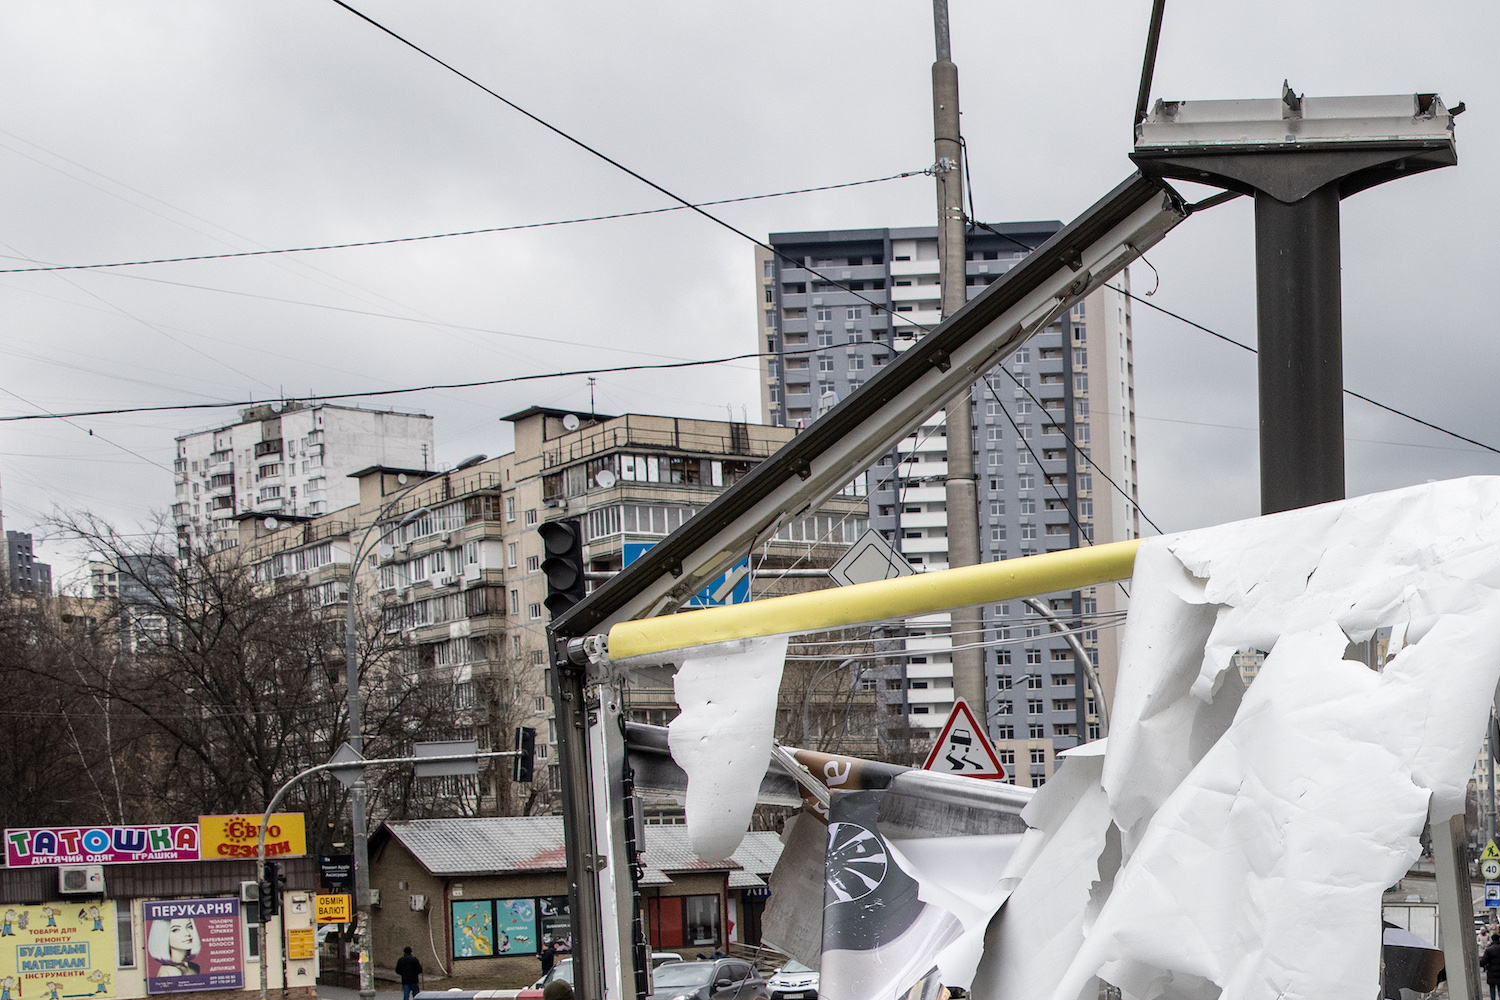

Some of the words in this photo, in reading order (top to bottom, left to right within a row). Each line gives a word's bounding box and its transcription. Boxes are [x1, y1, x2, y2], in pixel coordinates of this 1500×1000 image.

[9, 826, 198, 857] ТАТОШКА
[31, 854, 83, 865] ДИТЯЧИЙ
[86, 853, 114, 864] ОДЯГ
[132, 852, 178, 860] ІГРАШКИ
[1486, 865, 1497, 874] 40
[320, 897, 344, 905] ОБМІН
[152, 903, 232, 917] ПЕРУКАРНЯ
[319, 907, 345, 915] ВАЛЮТ
[20, 944, 86, 957] БУДІВЕЛЬНІ
[22, 958, 85, 970] МАТЕРІАЛИ
[25, 971, 85, 979] ІНСТРУМЕНТИ
